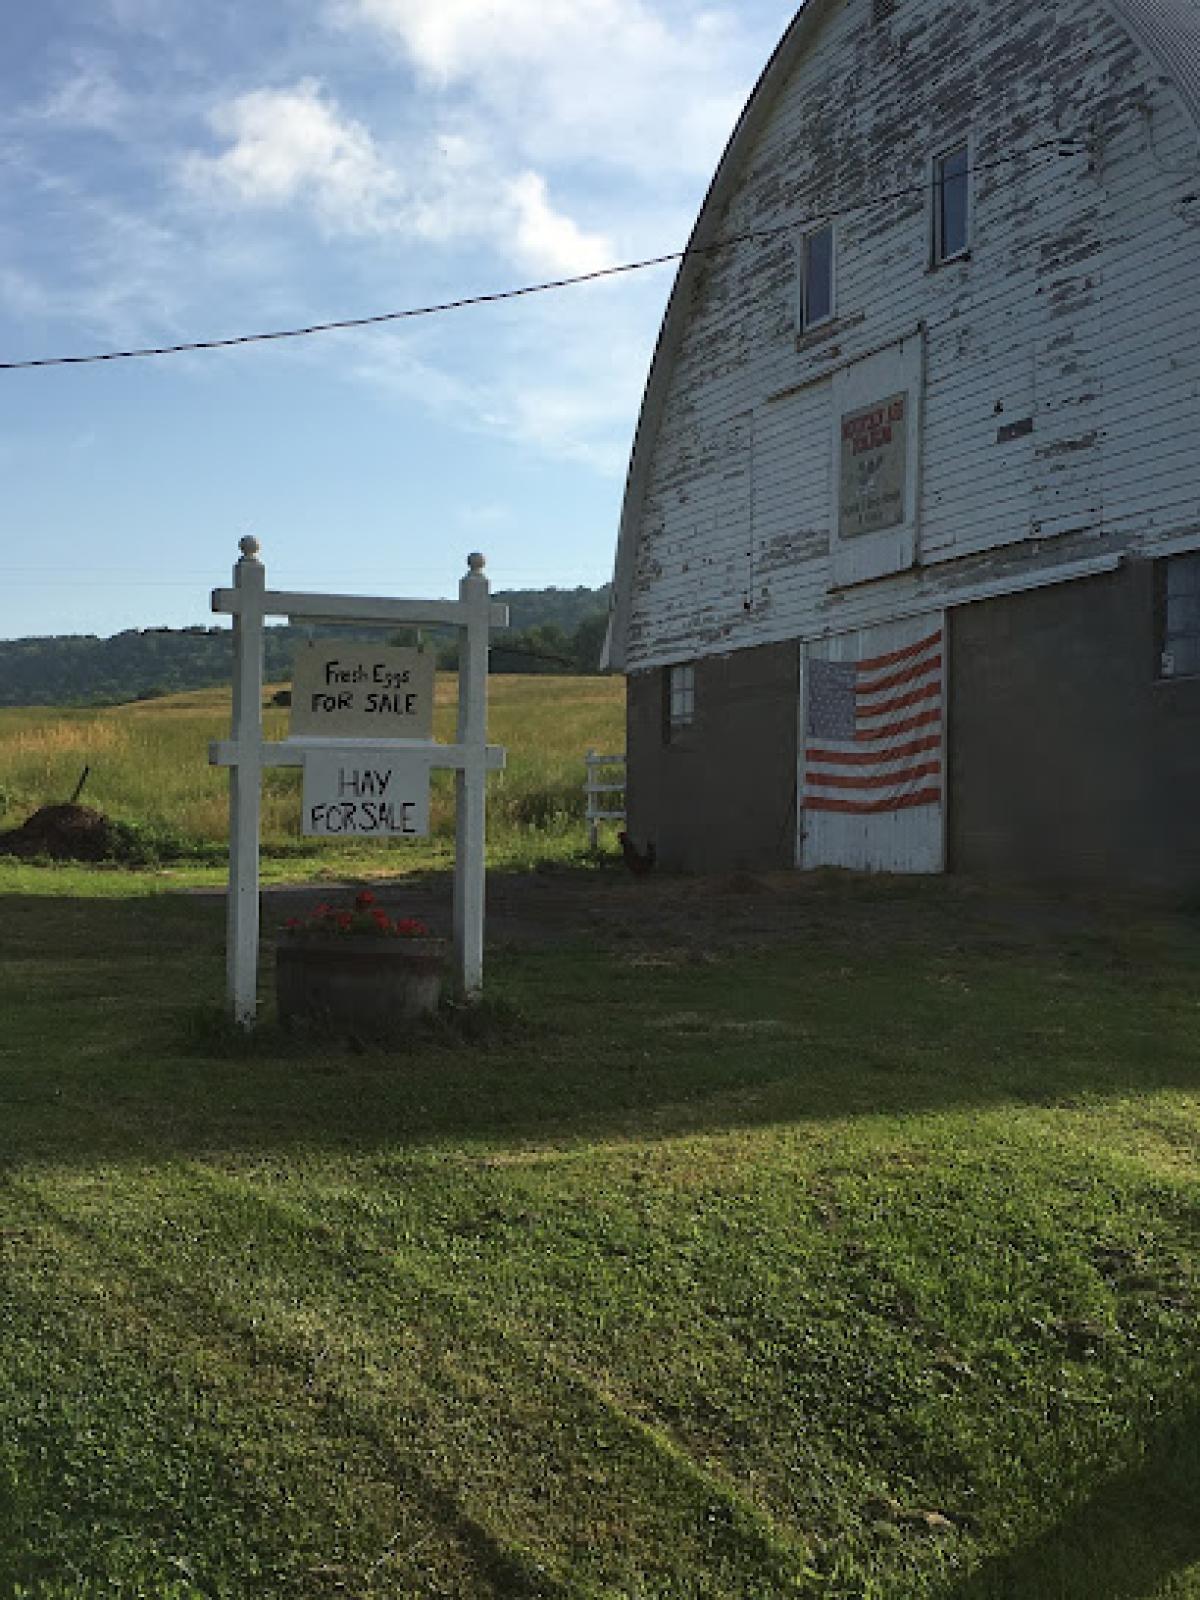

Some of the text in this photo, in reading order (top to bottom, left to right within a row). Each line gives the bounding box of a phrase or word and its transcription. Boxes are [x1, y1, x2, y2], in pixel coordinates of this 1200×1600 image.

[325, 661, 411, 689] Fresh Eggs
[312, 691, 418, 715] FOR SALE
[338, 767, 392, 797] HAY
